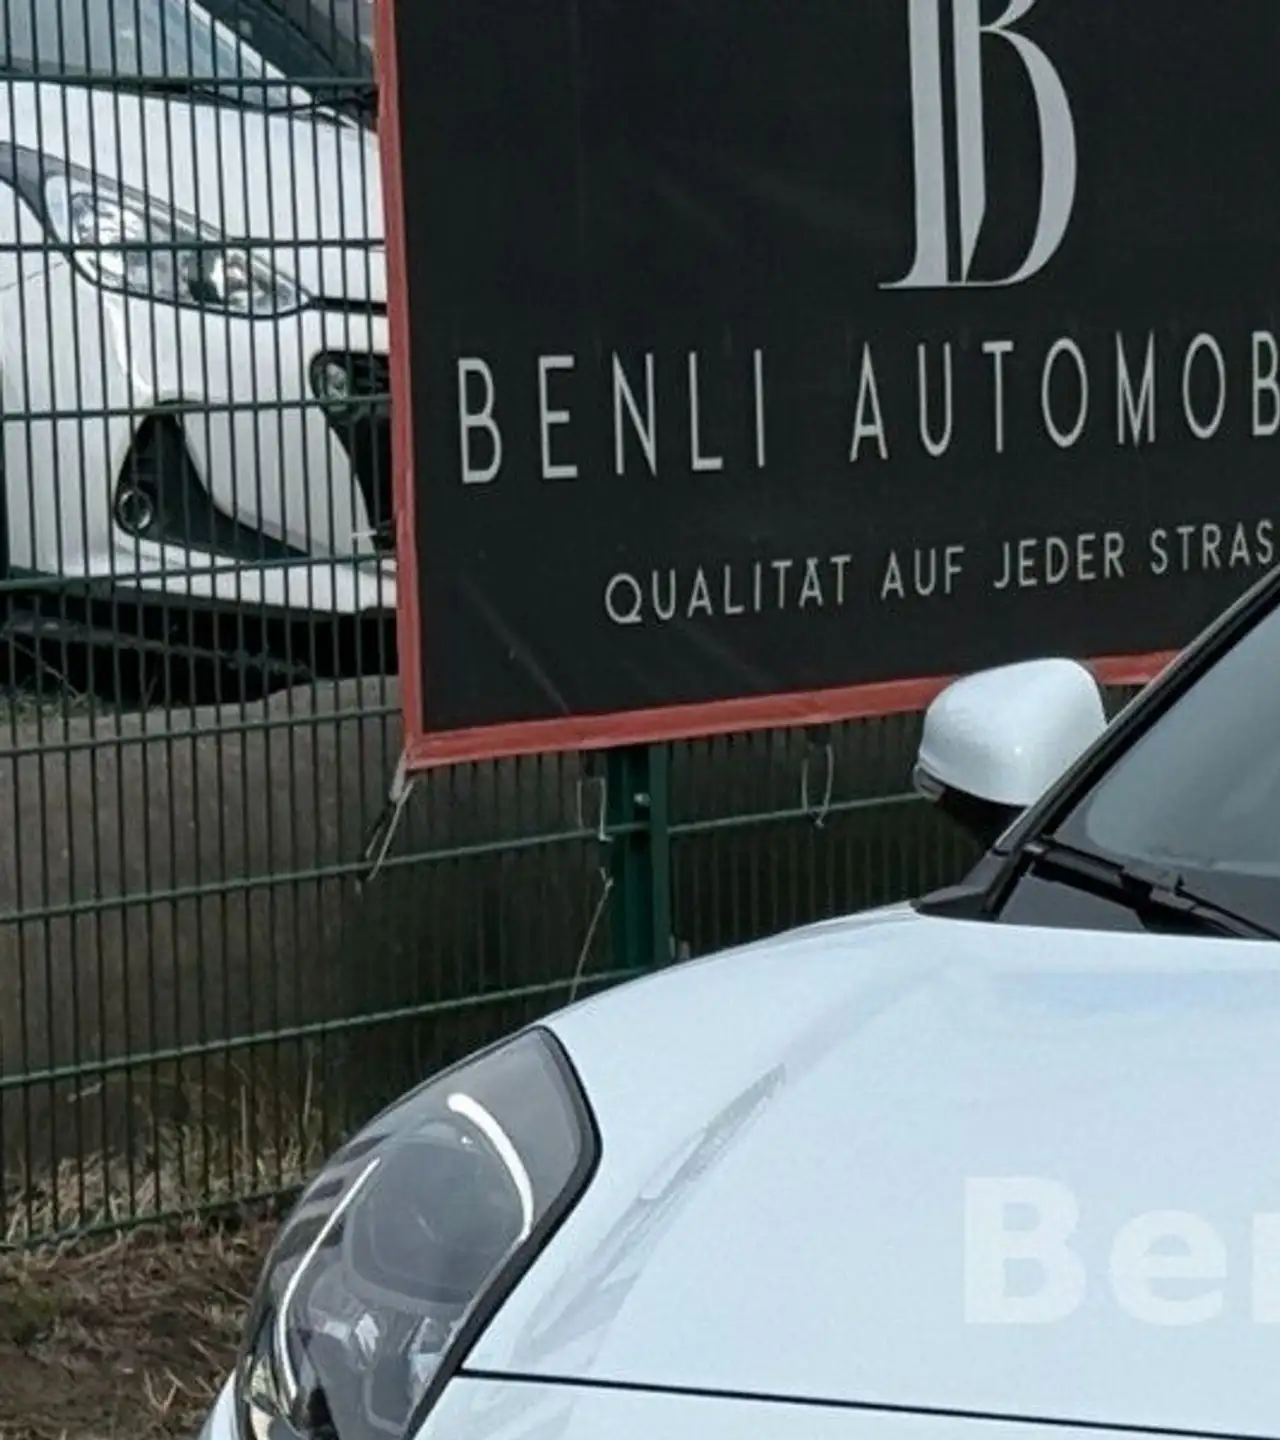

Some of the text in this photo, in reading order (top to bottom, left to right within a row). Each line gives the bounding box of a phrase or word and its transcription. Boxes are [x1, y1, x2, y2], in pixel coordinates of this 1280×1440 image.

[457, 348, 766, 484] BENLI
[881, 546, 965, 600] AUF
[993, 530, 1126, 590] JEDER
